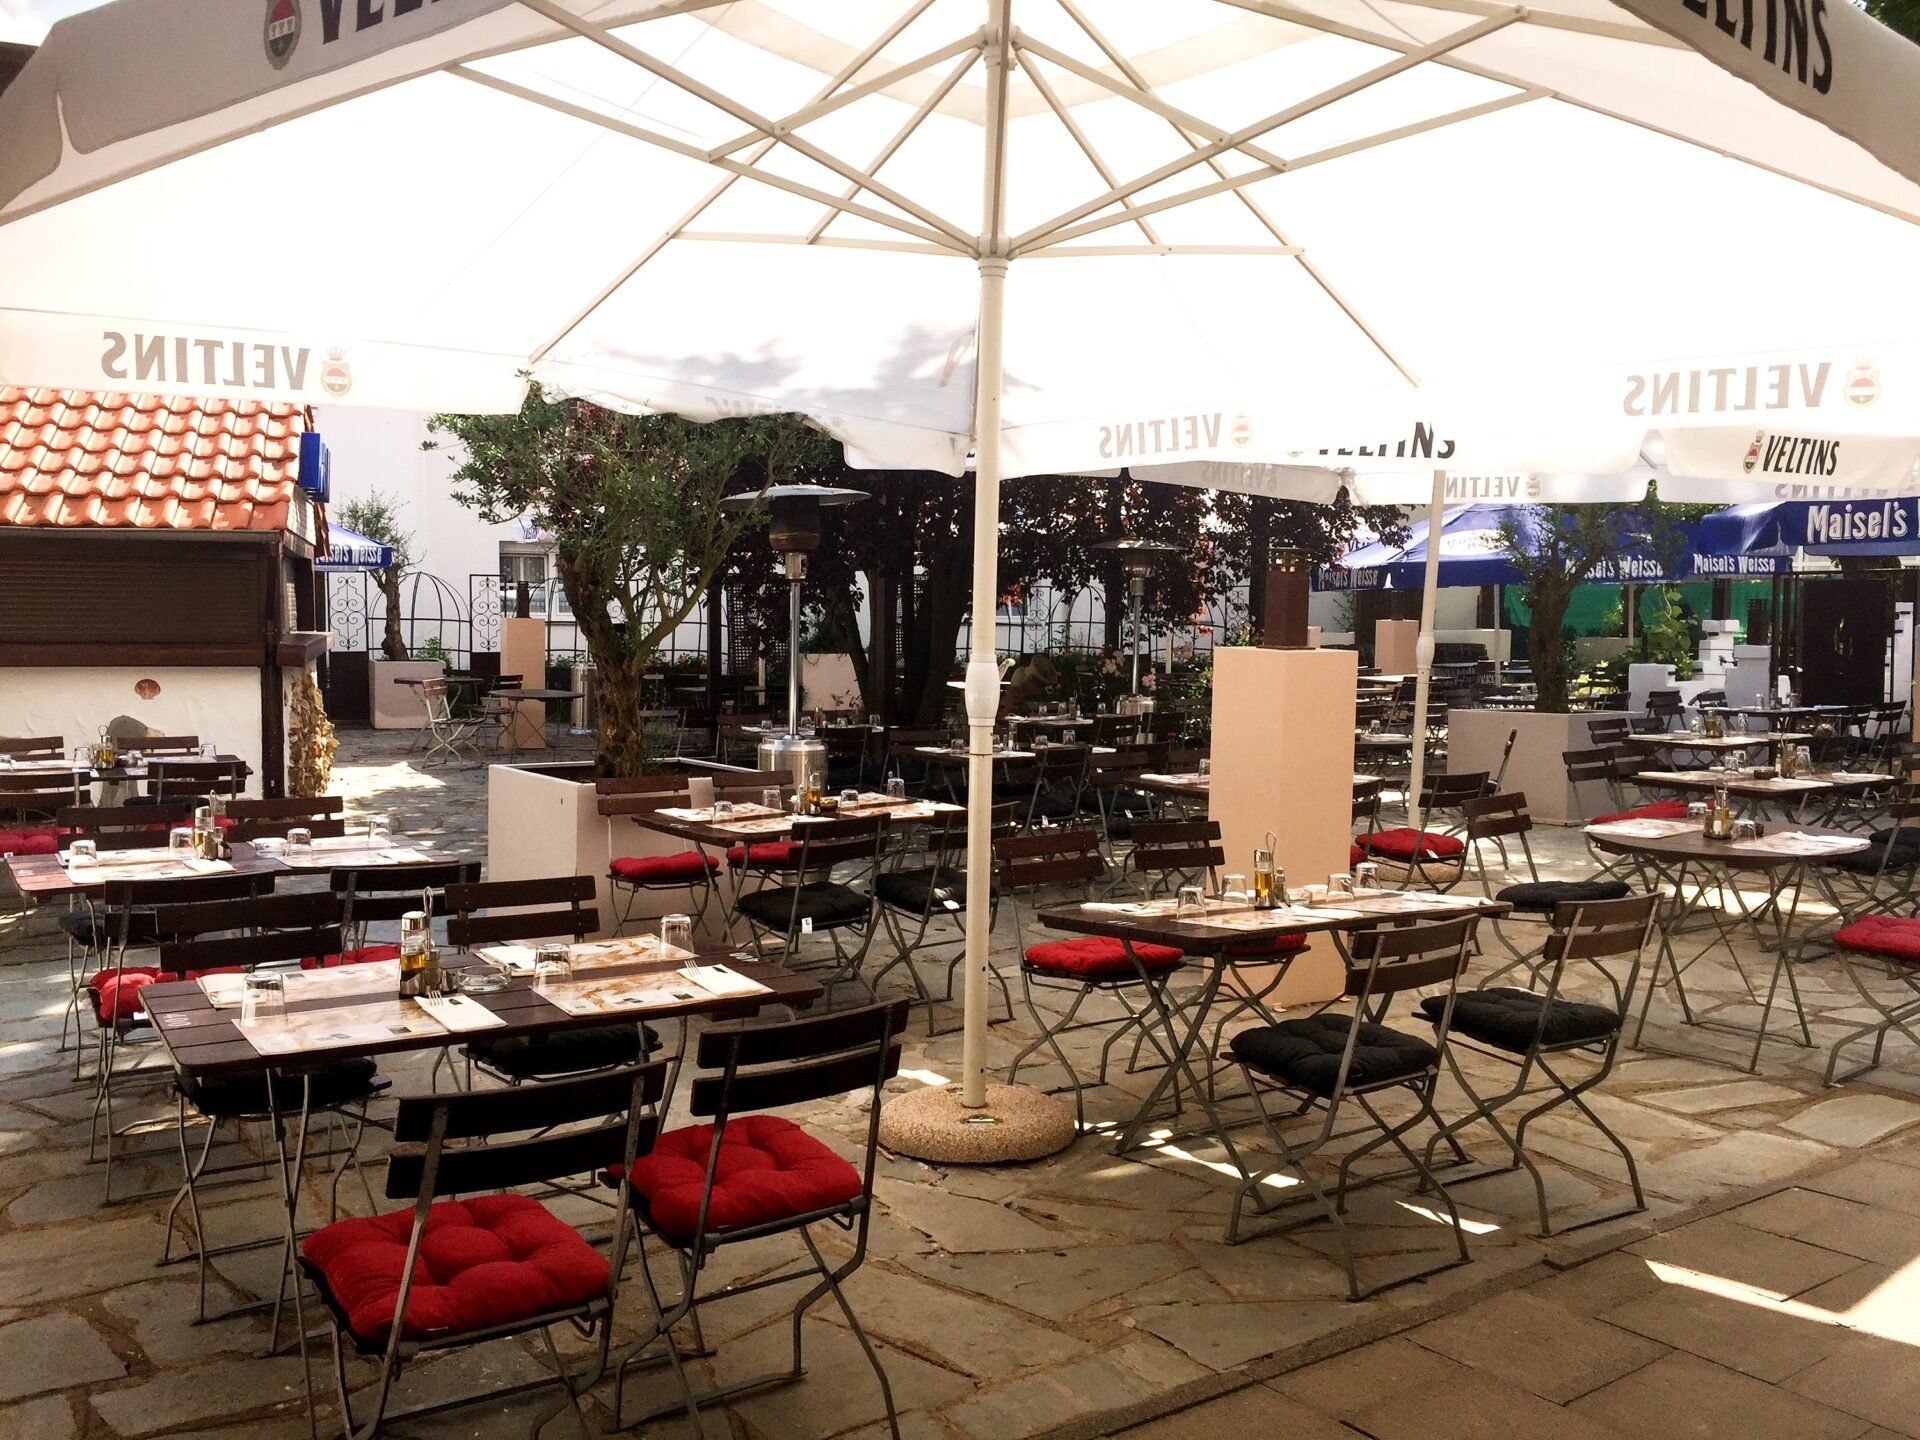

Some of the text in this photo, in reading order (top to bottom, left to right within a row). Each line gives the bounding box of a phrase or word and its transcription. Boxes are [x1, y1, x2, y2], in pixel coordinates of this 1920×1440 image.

[1763, 435, 1840, 476] VELTINS
[1807, 501, 1908, 543] Maisel's
[1350, 567, 1378, 588] Weisse
[1694, 554, 1775, 573] Maisel's Weisse
